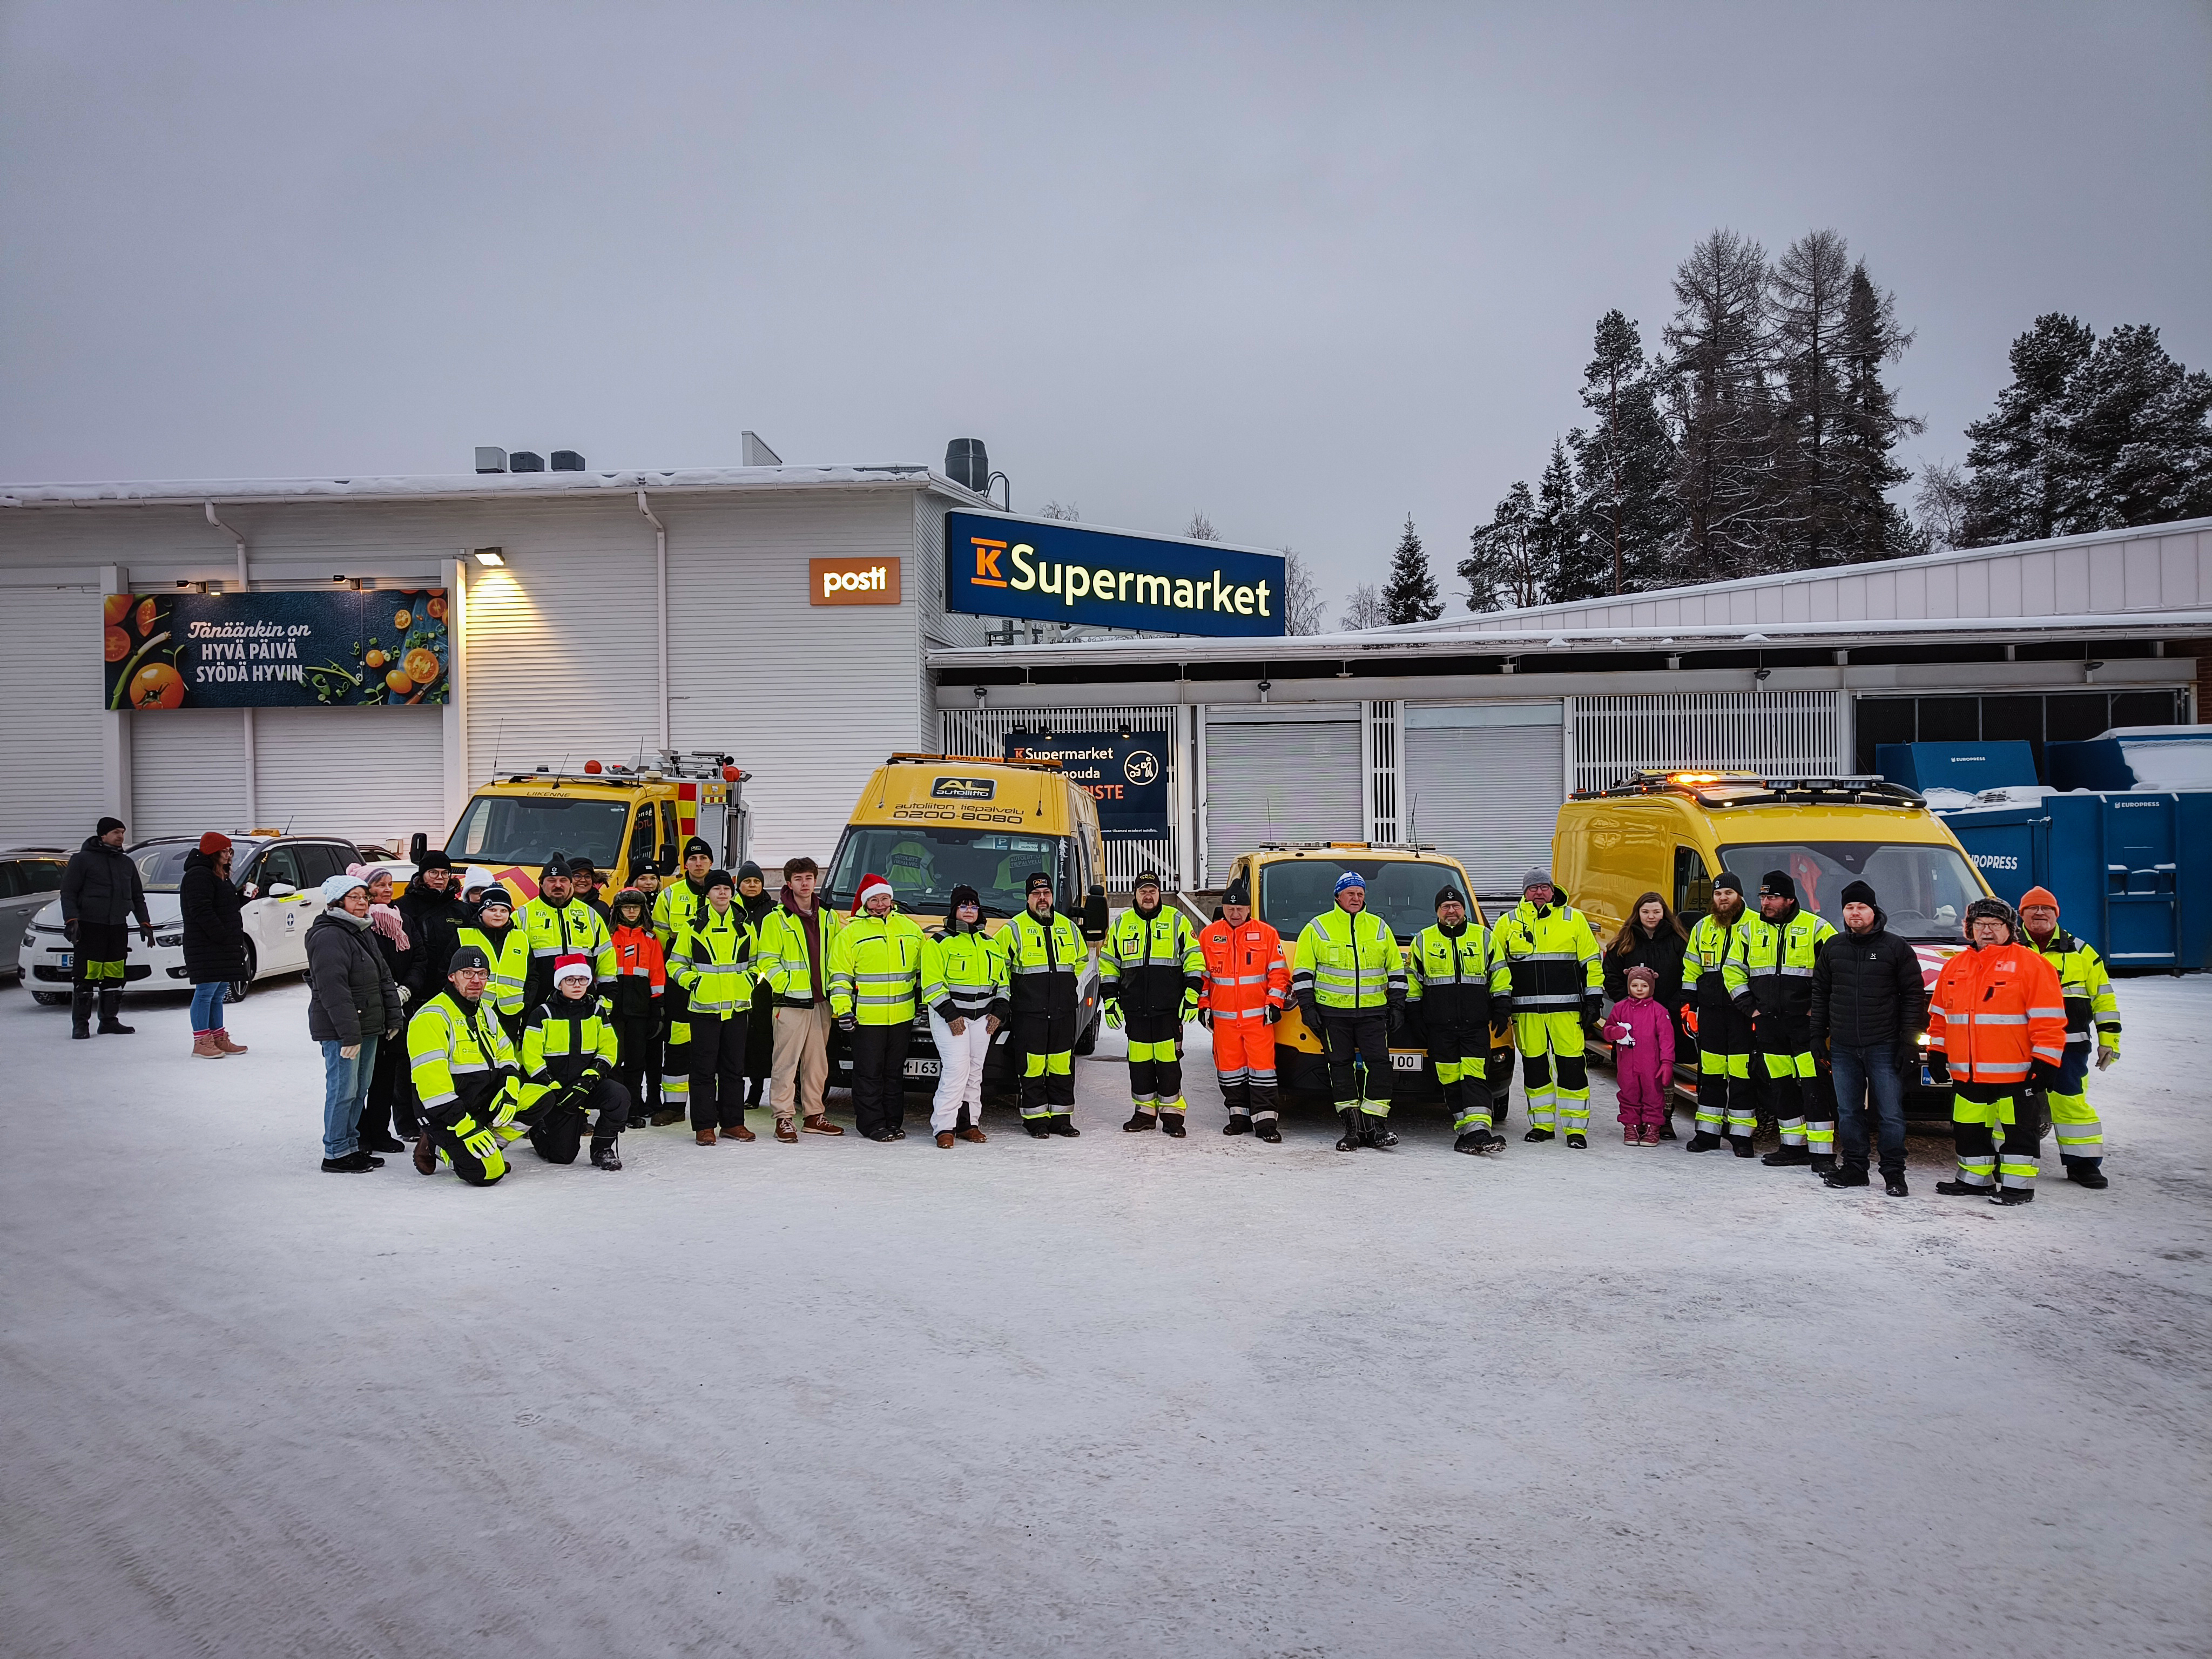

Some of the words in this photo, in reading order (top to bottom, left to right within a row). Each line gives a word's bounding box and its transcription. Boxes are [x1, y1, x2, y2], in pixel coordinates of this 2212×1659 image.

[824, 566, 887, 598] posti
[1010, 544, 1271, 617] Supermarket
[187, 620, 285, 638] Tänäänkin
[287, 624, 312, 637] on
[201, 639, 246, 660] HYVÄ
[249, 638, 298, 659] PÄIVÄ
[196, 661, 249, 683] SYÖDÄ
[252, 664, 303, 682] HYVIN
[1025, 746, 1114, 761] Supermarket
[1061, 766, 1101, 779] nouda
[935, 789, 989, 797] autoliitto
[895, 802, 955, 811] autoliiton
[960, 804, 1024, 815] tiepalvelu
[893, 811, 1023, 825] 0200-8080
